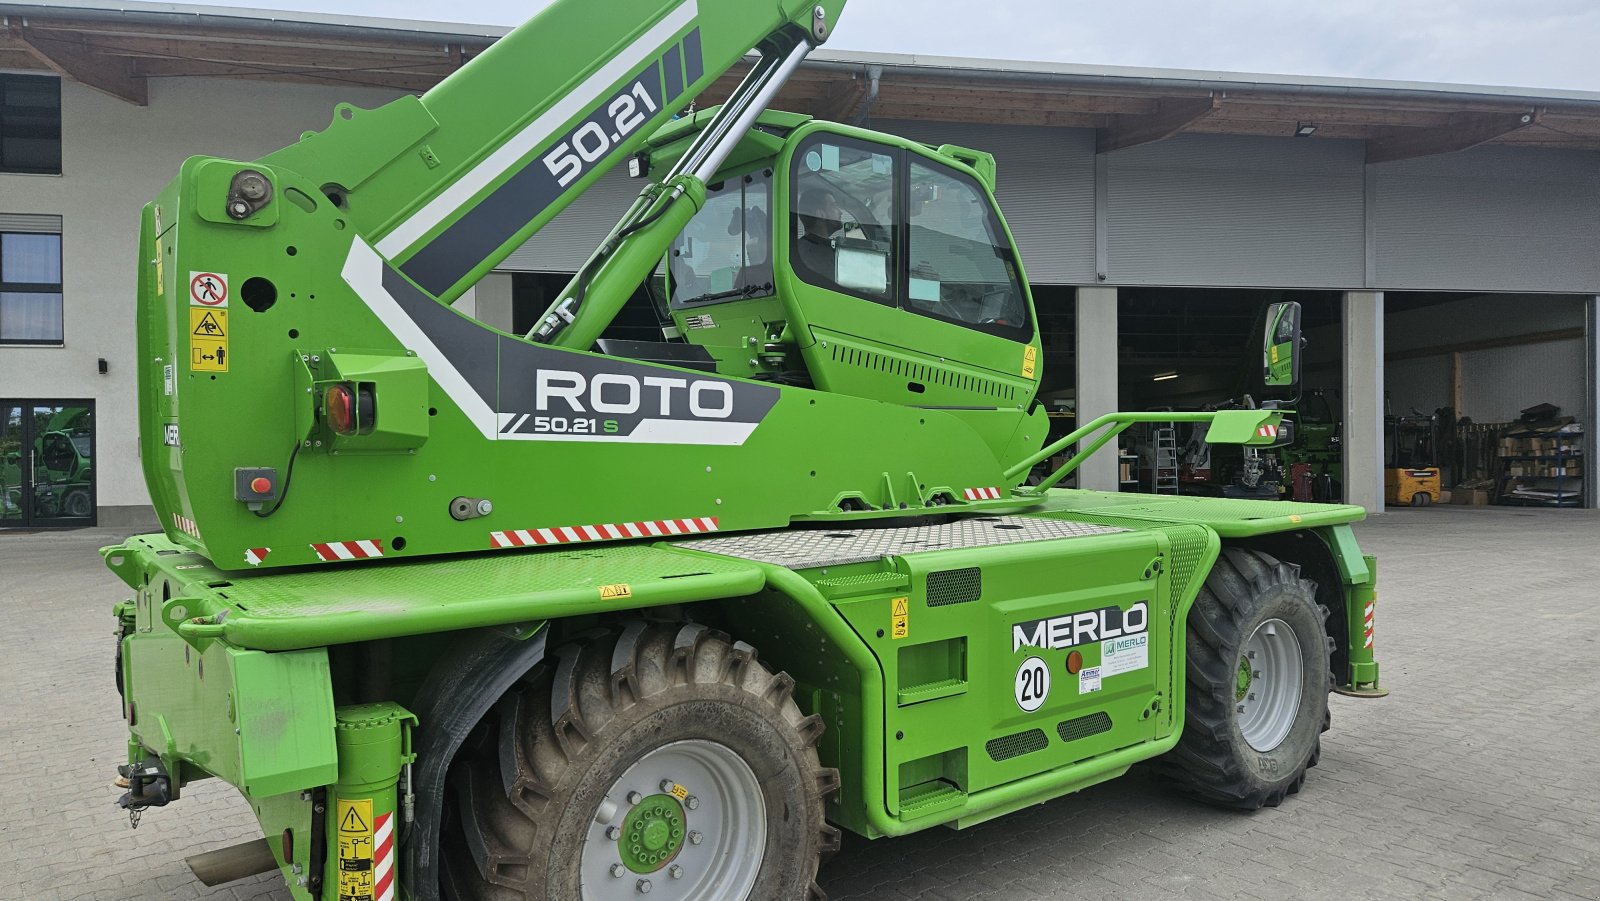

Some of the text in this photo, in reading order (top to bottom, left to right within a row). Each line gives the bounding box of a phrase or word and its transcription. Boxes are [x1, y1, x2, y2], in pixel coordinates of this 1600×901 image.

[542, 81, 657, 187] 50.21
[536, 369, 733, 418] ROTO
[534, 417, 618, 433] 50.21 S
[1013, 602, 1147, 654] MERLO
[1117, 636, 1146, 650] MERLO
[1021, 666, 1044, 702] 20
